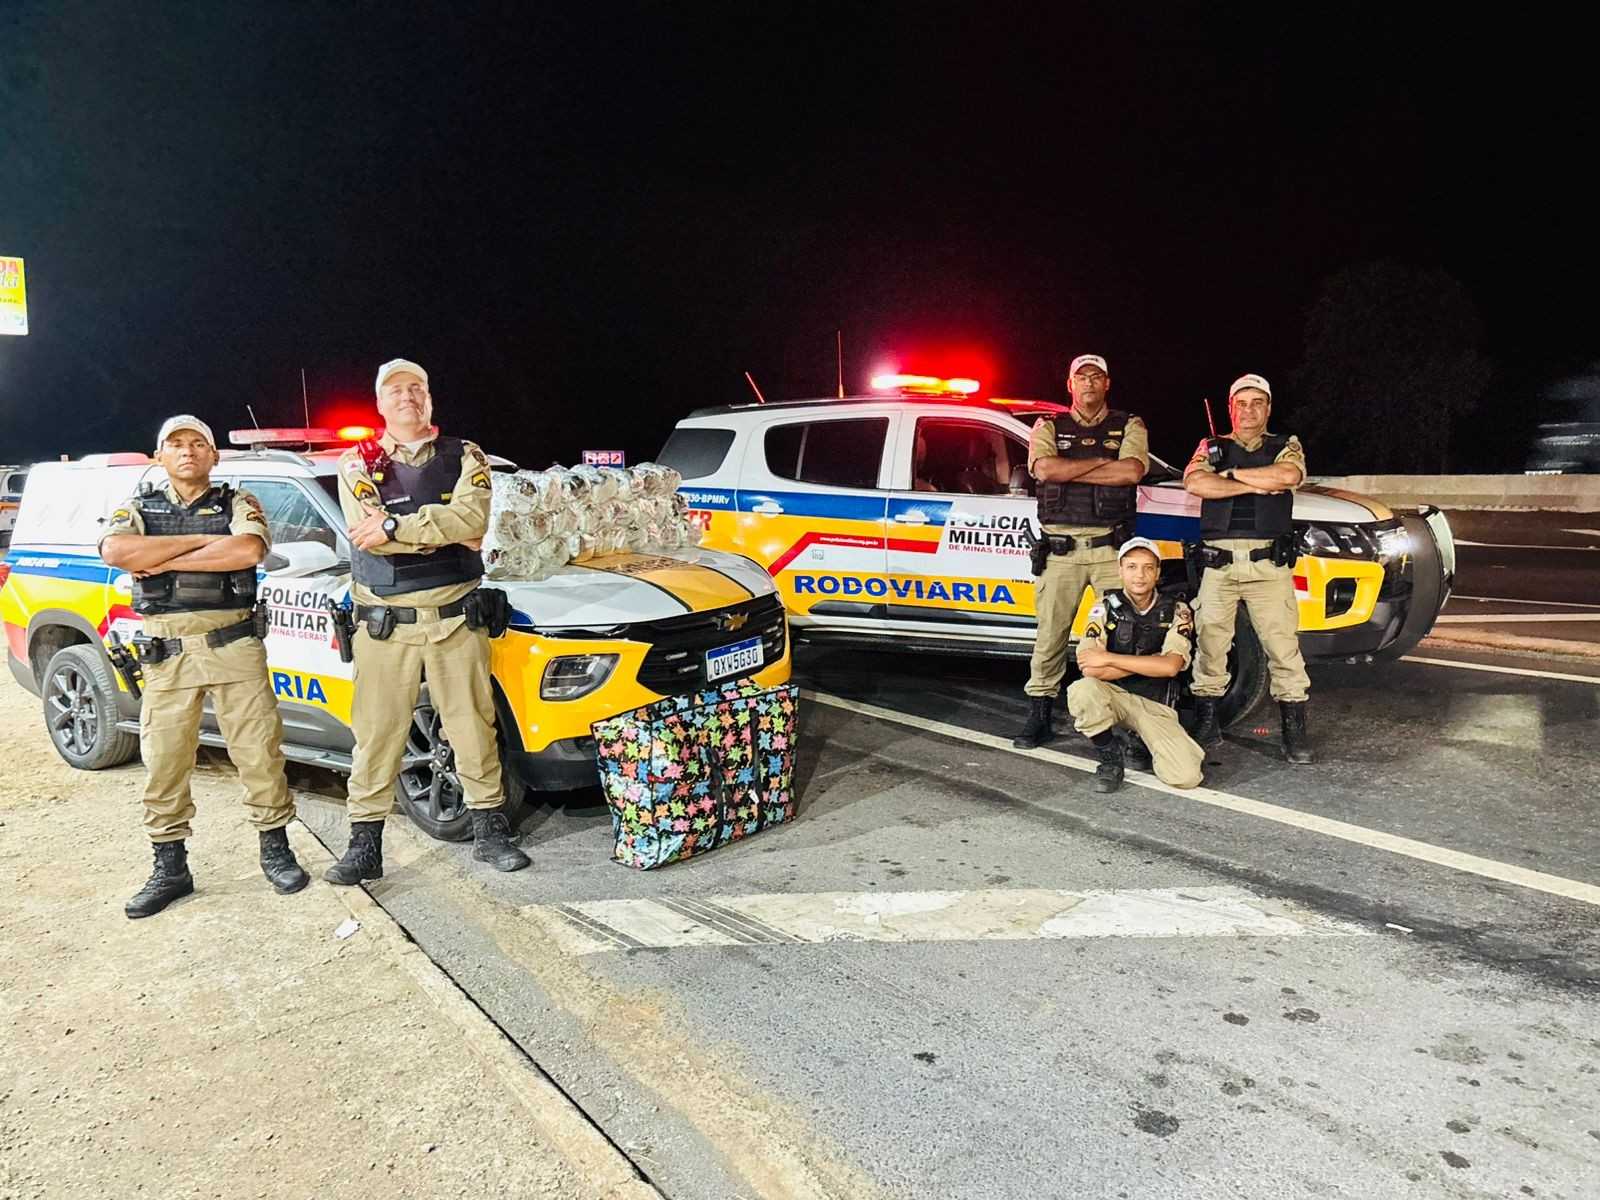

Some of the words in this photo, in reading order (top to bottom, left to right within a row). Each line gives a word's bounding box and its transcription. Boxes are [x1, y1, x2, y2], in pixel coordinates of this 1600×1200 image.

[949, 529, 1031, 549] MILITAR
[948, 543, 960, 551] DE
[962, 545, 993, 554] MINAS
[298, 631, 329, 642] GERAIS
